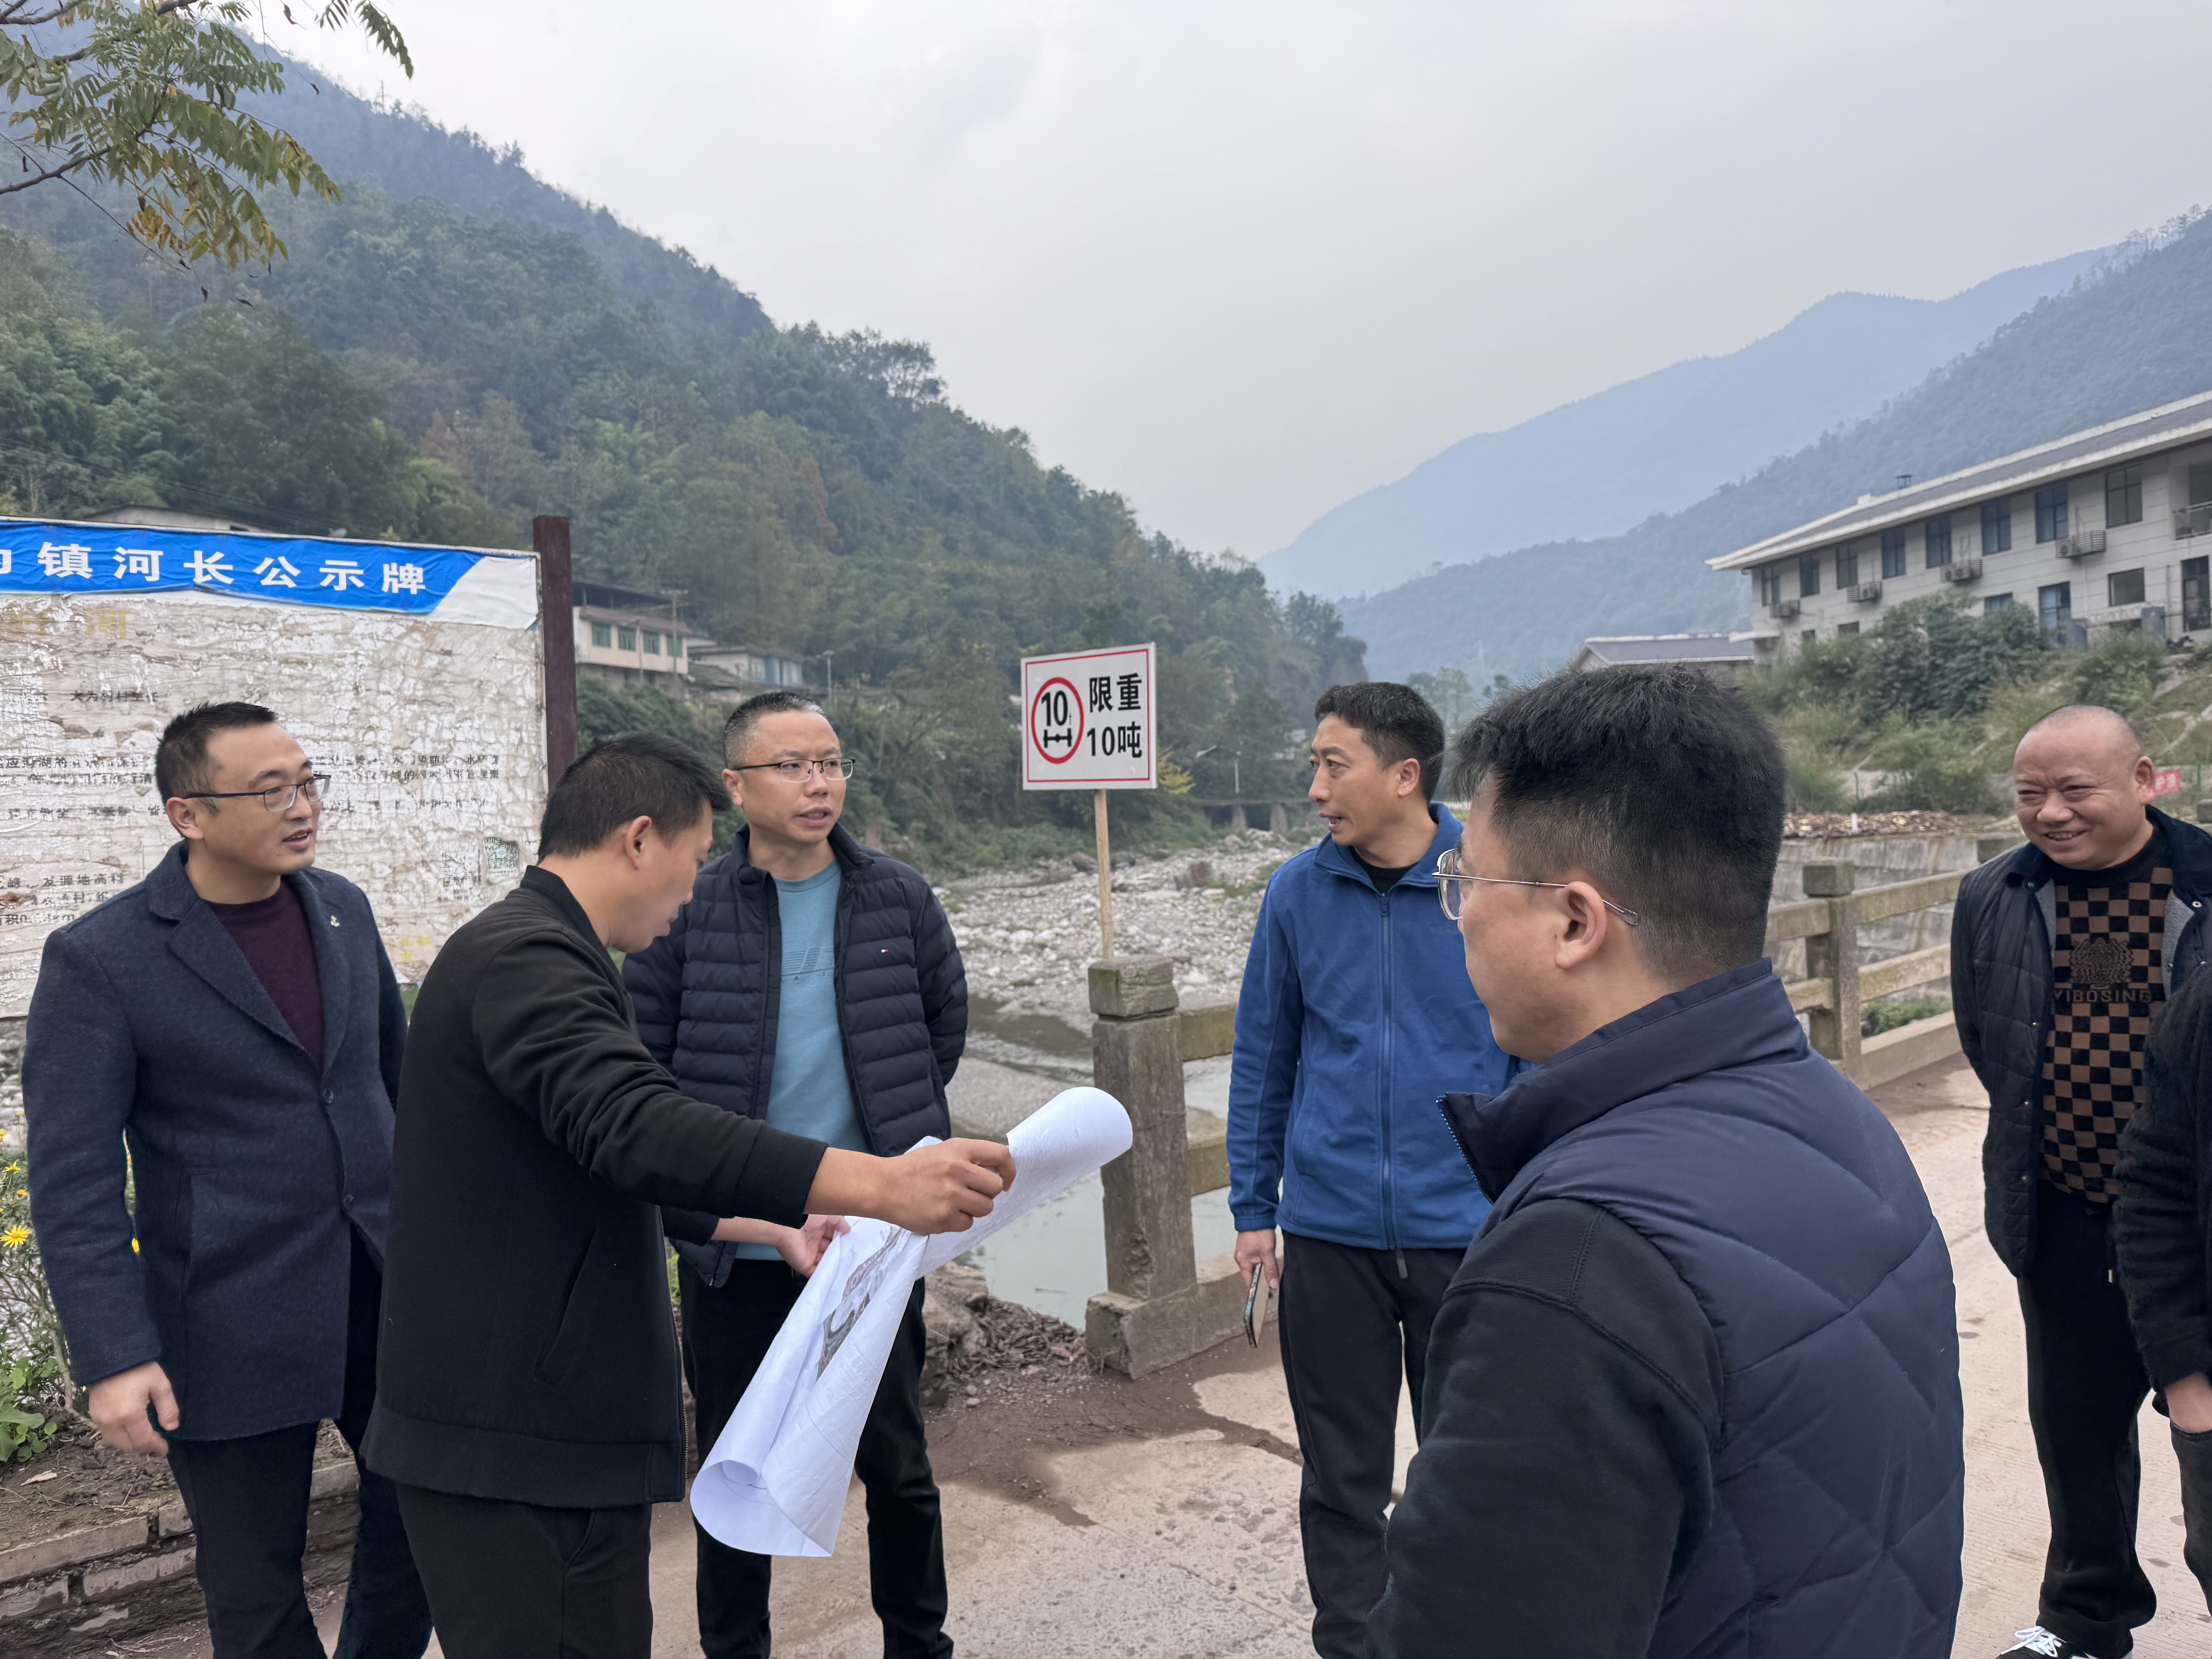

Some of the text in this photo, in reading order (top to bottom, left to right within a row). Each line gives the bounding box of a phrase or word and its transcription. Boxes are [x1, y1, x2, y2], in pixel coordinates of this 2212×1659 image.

[0, 541, 426, 595] 镇河长公示牌
[1089, 673, 1142, 713] 限重
[1087, 721, 1142, 758] 10吨
